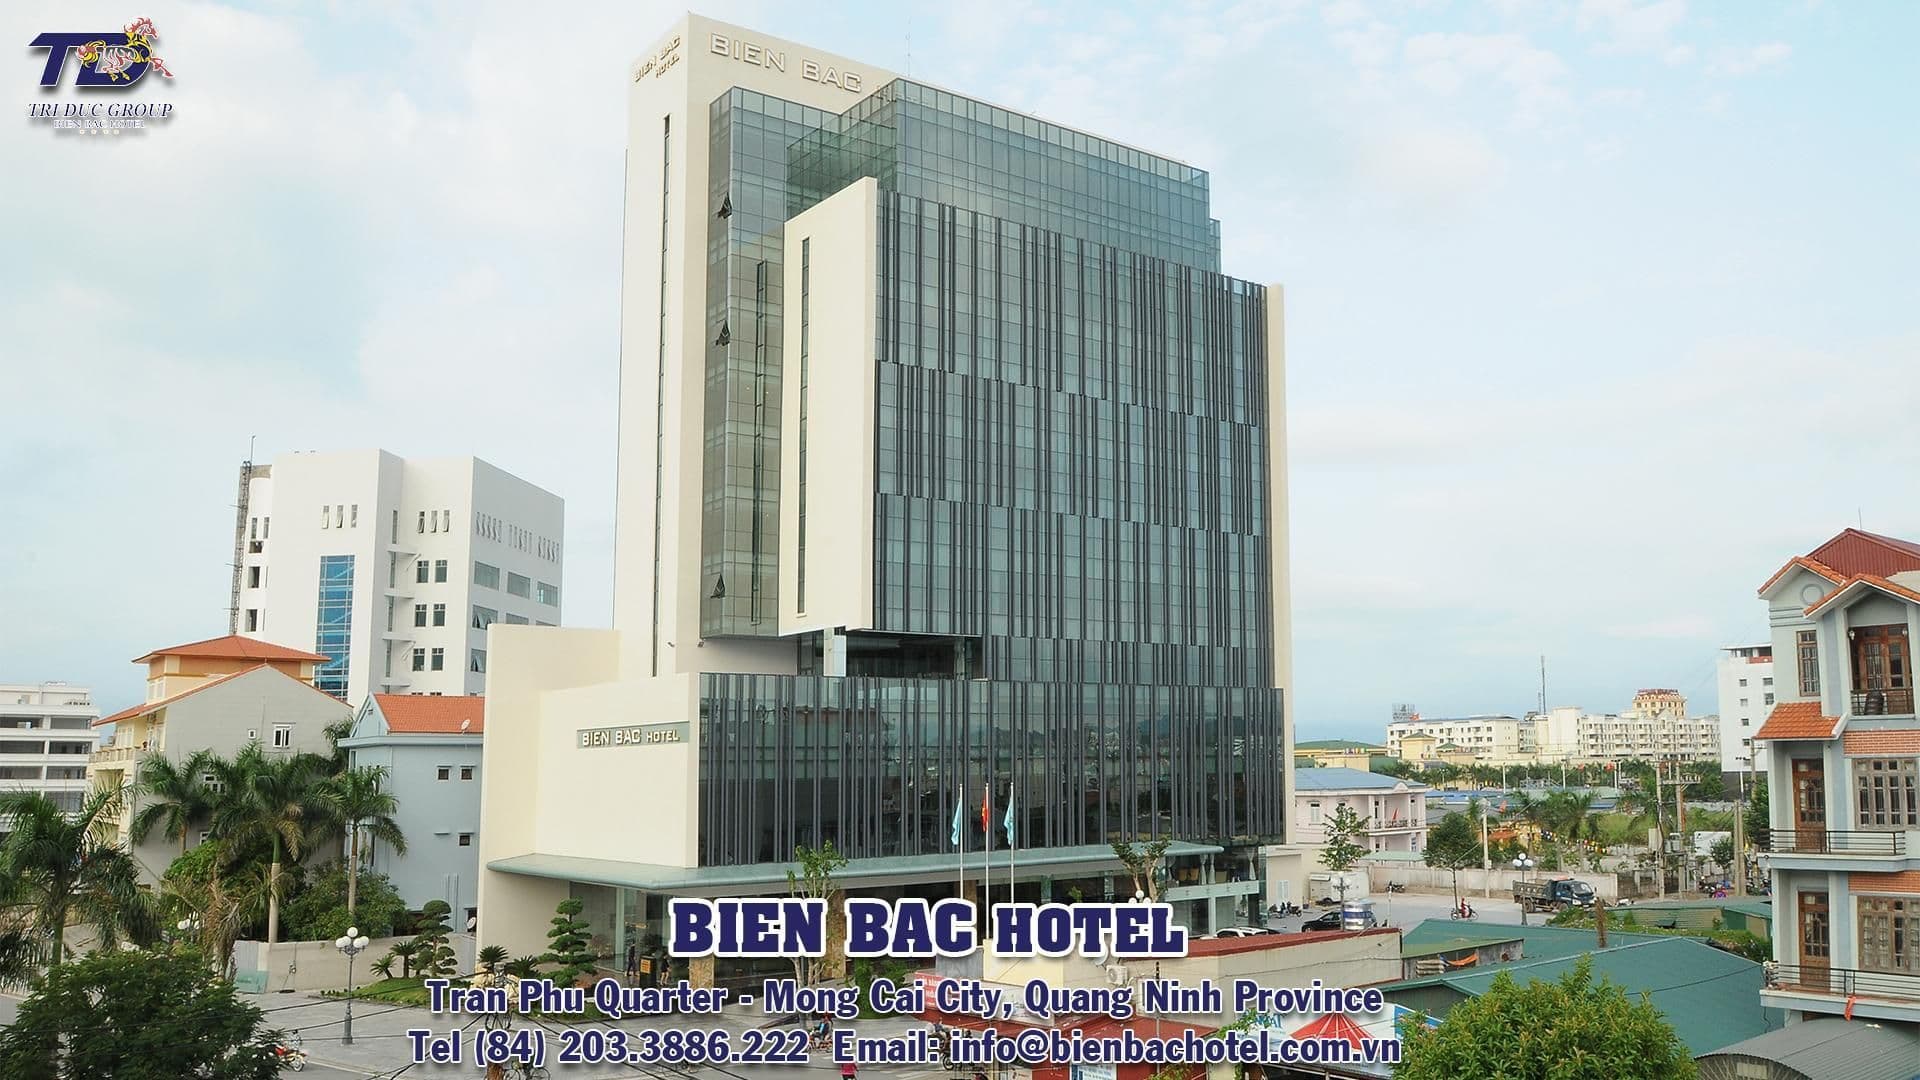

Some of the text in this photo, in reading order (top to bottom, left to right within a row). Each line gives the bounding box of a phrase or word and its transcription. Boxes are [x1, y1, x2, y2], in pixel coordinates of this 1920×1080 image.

[633, 55, 658, 83] BIEN
[710, 32, 786, 73] BIEN
[802, 58, 862, 94] BAC
[582, 728, 680, 747] BIEN BAC HOTEL
